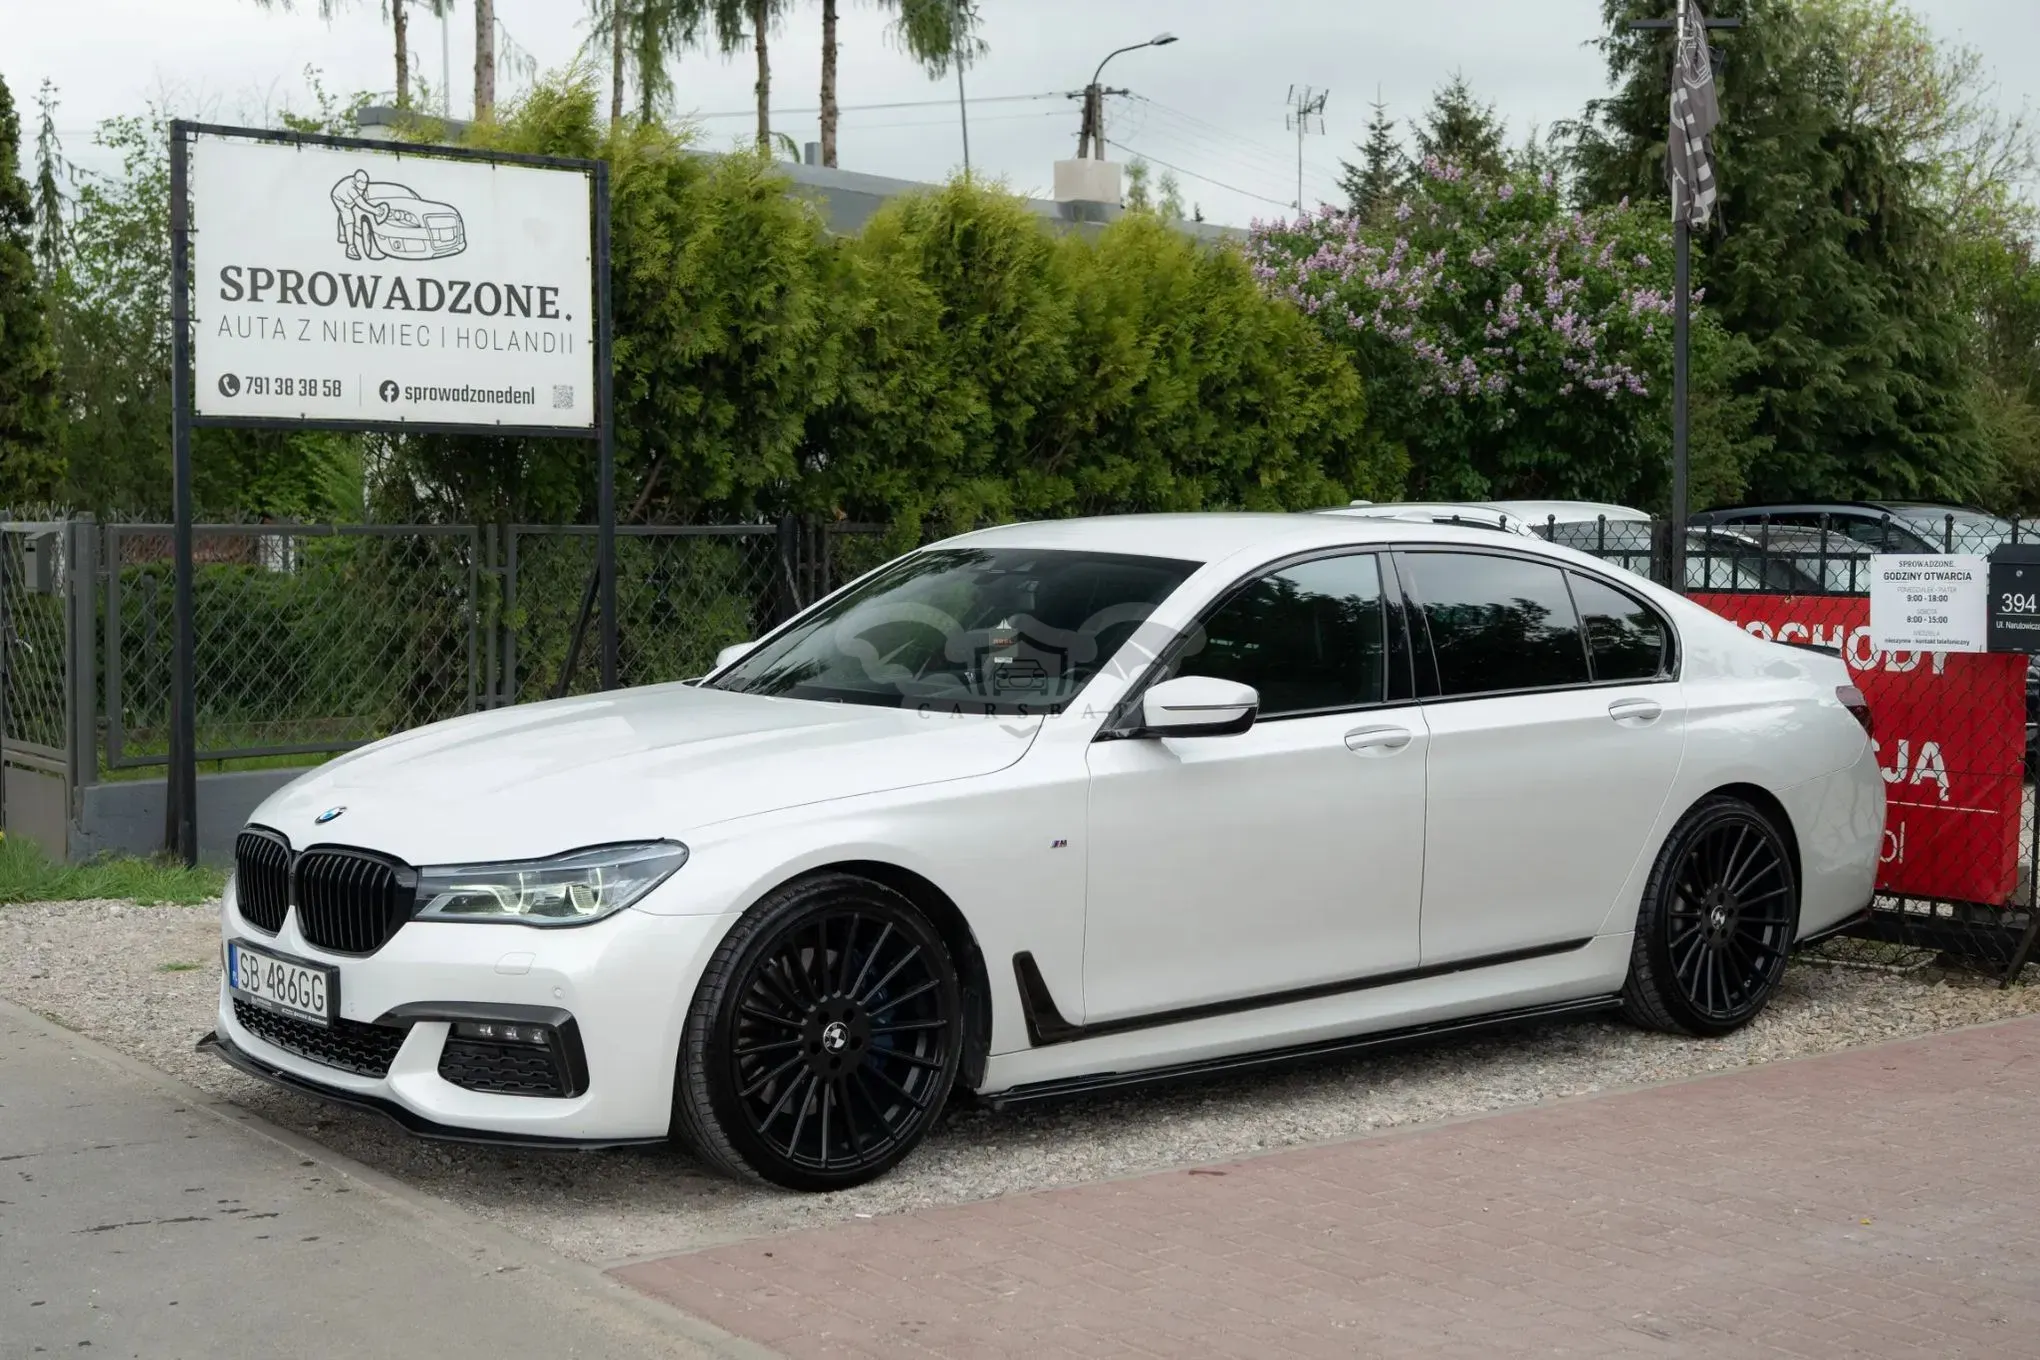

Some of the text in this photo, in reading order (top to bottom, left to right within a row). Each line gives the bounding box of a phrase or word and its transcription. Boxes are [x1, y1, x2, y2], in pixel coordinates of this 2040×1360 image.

[219, 265, 573, 322] SPROWADZONE.
[217, 314, 287, 341] AUTA
[298, 318, 312, 342] Z
[322, 320, 431, 348] NIEMIEC
[456, 327, 574, 355] HOLANDII
[404, 383, 536, 406] sprowadzonedenl
[1883, 571, 1972, 581] GODZINY OTWARCIA
[2001, 592, 2037, 614] 394
[1906, 615, 1923, 623] 8:00
[1928, 616, 1949, 624] 15:00
[1872, 738, 1950, 802] JĄ
[240, 952, 324, 1012] SB 486GG
